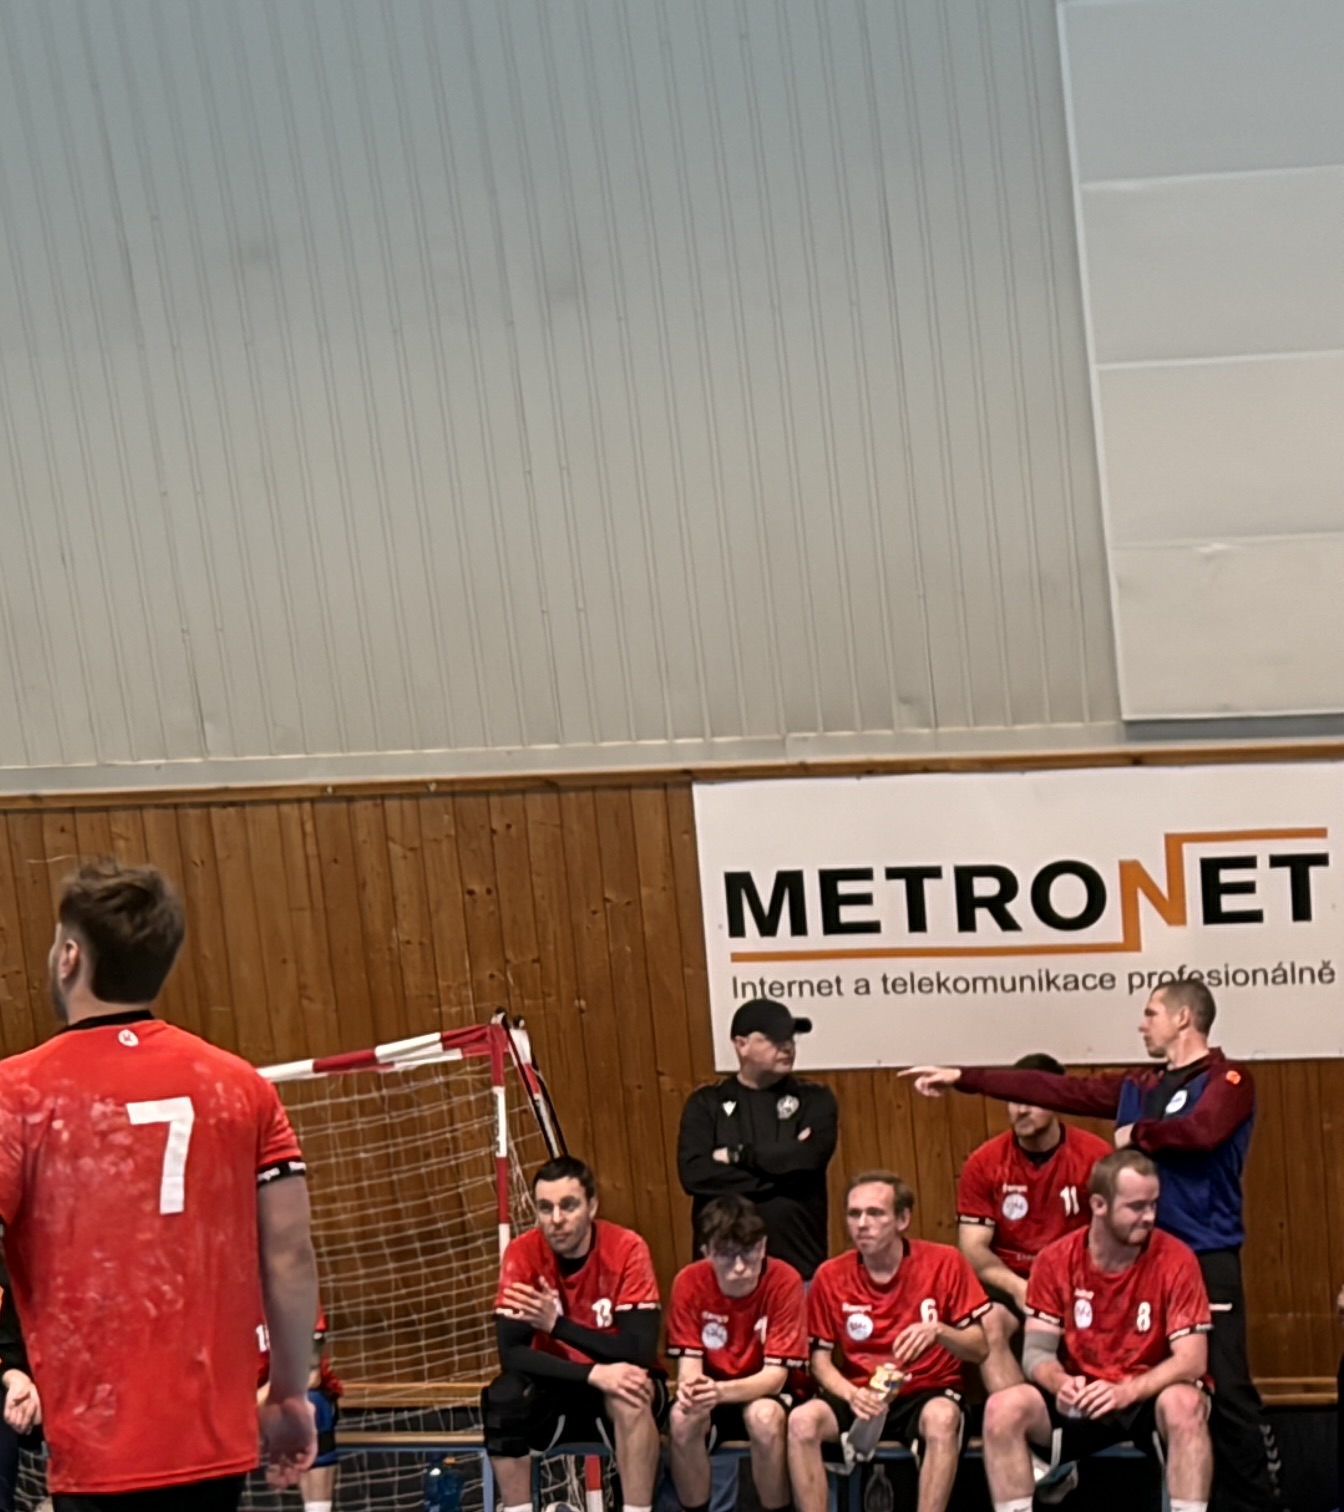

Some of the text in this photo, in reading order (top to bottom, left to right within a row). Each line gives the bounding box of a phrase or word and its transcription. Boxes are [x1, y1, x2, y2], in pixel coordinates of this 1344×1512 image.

[724, 833, 1330, 951] METRONET
[732, 960, 1336, 1000] Internet a telekomunikace profesionálně
[125, 1096, 195, 1215] 7
[1136, 1301, 1152, 1333] 8
